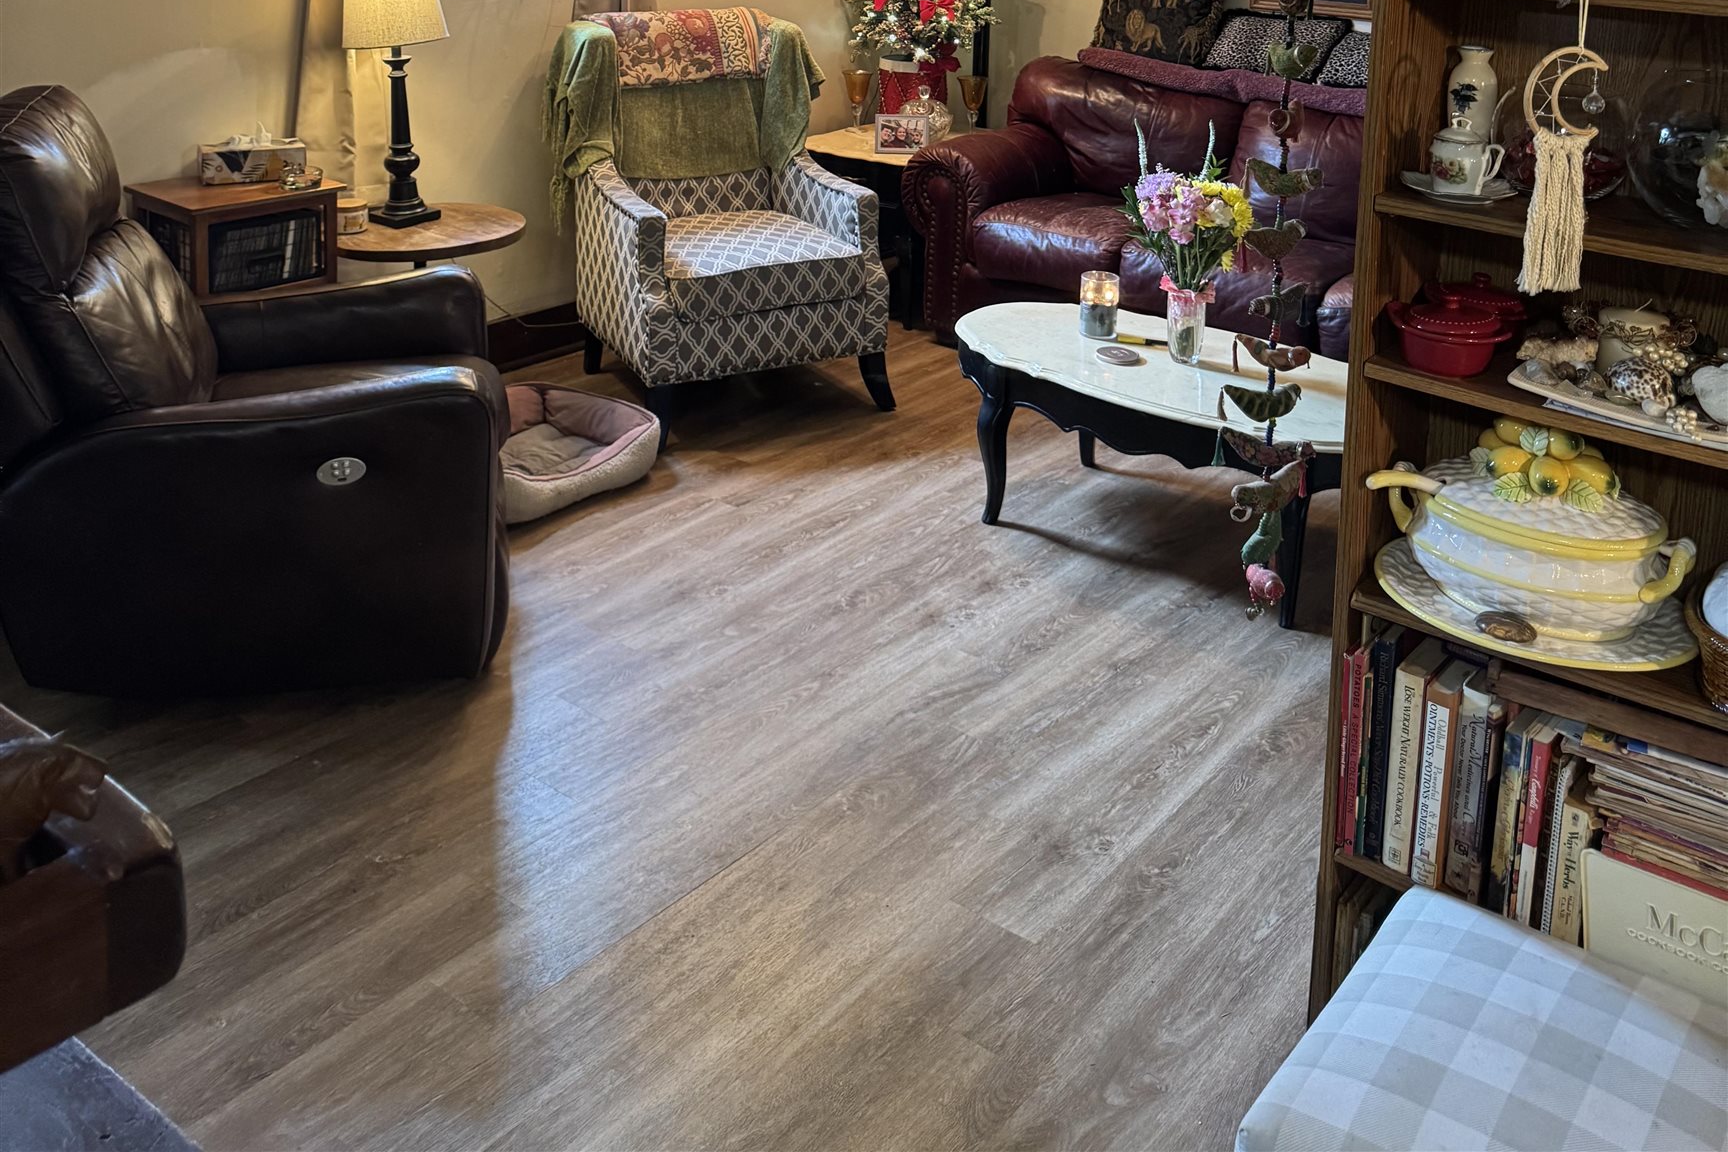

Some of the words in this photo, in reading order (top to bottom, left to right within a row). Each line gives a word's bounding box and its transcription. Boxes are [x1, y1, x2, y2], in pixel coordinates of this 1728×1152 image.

[1377, 651, 1389, 683] Richard
[1352, 663, 1361, 707] POTATOES
[1349, 722, 1358, 756] SPECIAL
[1435, 718, 1446, 750] Oddball
[1460, 724, 1468, 737] Your
[1466, 713, 1486, 751] Natural
[1458, 737, 1467, 758] Doctor
[1456, 758, 1464, 775] Never
[1464, 749, 1482, 794] Medicines
[1346, 760, 1356, 814] COLLECTION
[1429, 765, 1442, 801] Powerful
[1453, 789, 1461, 800] You
[1428, 810, 1437, 819] &
[1451, 800, 1459, 819] About
[1463, 794, 1471, 809] and
[1426, 821, 1437, 839] Folk
[1563, 830, 1579, 850] Way
[1561, 857, 1577, 890] Herbs
[1627, 928, 1705, 966] COOKBOOK
[1646, 902, 1728, 962] McC
